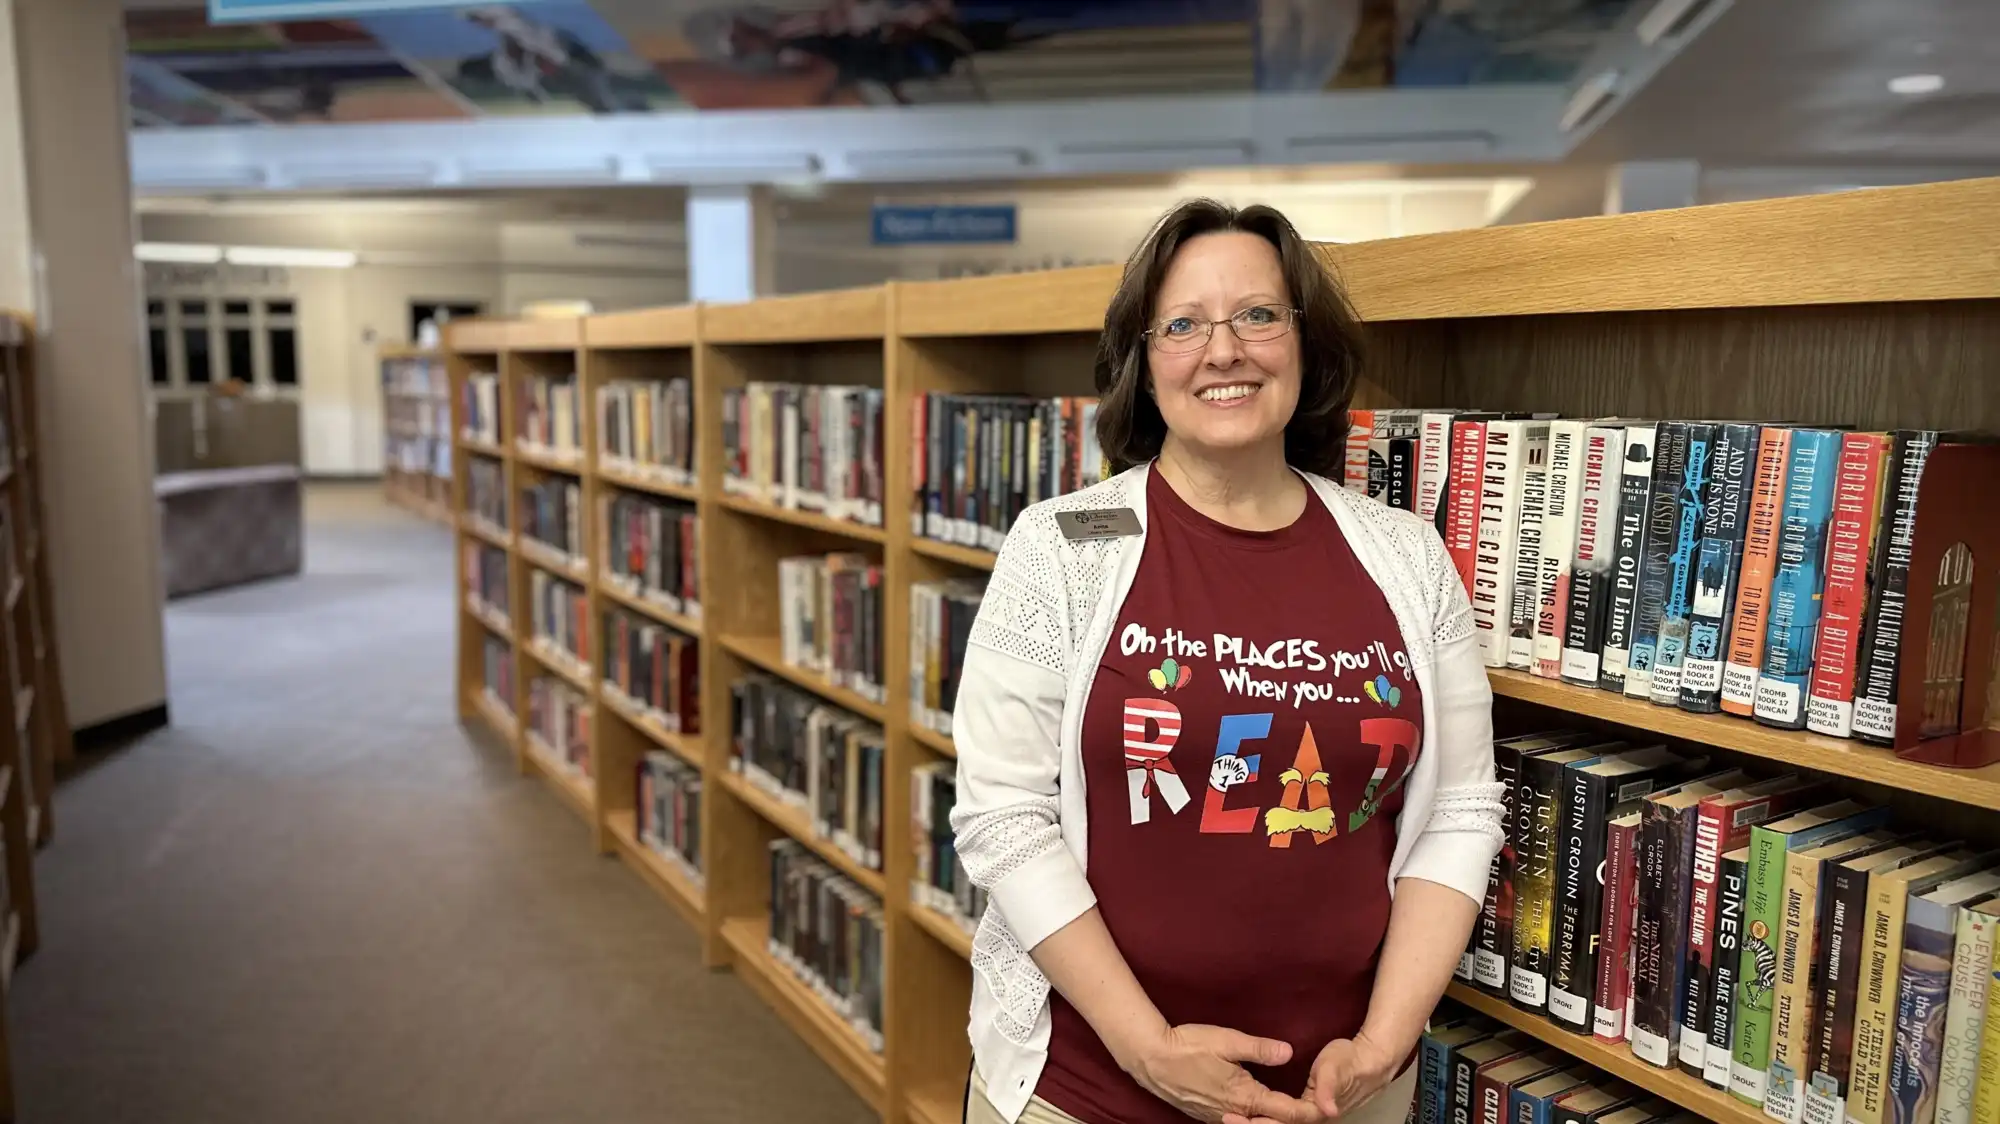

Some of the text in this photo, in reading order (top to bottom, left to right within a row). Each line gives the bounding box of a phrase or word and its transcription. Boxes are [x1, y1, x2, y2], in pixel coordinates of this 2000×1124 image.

[1424, 422, 1442, 473] MICHAEL
[1656, 432, 1672, 473] CROMBIE
[1670, 434, 1685, 475] DEBORAH
[1392, 454, 1402, 505] DISCLO
[1455, 429, 1480, 550] MICHAEL CRICHTON
[1548, 432, 1572, 517] MICHAEL CRICHTON
[1704, 438, 1730, 535] THERE IS NONE
[1720, 447, 1745, 529] AND JUSTICE
[1578, 436, 1605, 560] MICHAEL CRICHTON
[1650, 492, 1676, 535] KISSED
[1748, 440, 1784, 558] DEBORAH CROMBIE
[1780, 448, 1817, 576] DEBORAH CROMBIE
[1886, 440, 1929, 571] DEBORAH CROMBIE
[1474, 432, 1508, 630] MICHAEL CRICHTO
[1480, 528, 1502, 537] NEXT
[1516, 471, 1546, 588] MICHAEL CRICHTON
[1622, 513, 1640, 548] The
[1828, 441, 1870, 592] DEBORAH CROMBIE
[1649, 538, 1670, 546] A
[1616, 556, 1635, 590] Old
[1646, 550, 1668, 576] SAD
[1540, 557, 1560, 606] RISING
[1573, 569, 1592, 622] STATE OF
[1512, 588, 1526, 625] LATITUDES
[1524, 594, 1536, 621] PIRATE
[1607, 596, 1631, 649] Limey
[1638, 580, 1665, 634] GOODBYE
[1738, 586, 1762, 633] TO DWELL
[1772, 591, 1796, 644] GARDEN OF
[1818, 612, 1850, 676] A BITTER
[1872, 589, 1906, 665] A KILLING OF
[1120, 622, 1412, 682] Oh the PLACES you'll g
[1687, 662, 1715, 672] CROMB
[1218, 668, 1288, 699] When
[1654, 676, 1671, 684] BOOK
[1684, 678, 1716, 688] DUNCAN
[1686, 670, 1714, 680] BOOK 8
[1722, 685, 1751, 698] DUNCAN
[1726, 670, 1751, 682] CROMB
[1742, 682, 1753, 691] 16
[1760, 687, 1787, 698] CROMB
[1681, 695, 1708, 705] BANTAM
[1756, 704, 1788, 716] DUNCAN
[1758, 695, 1777, 706] BOOK
[1808, 709, 1840, 720] BOOK 18
[1810, 700, 1838, 712] CROMB
[1856, 710, 1894, 724] BOOK 19
[1860, 702, 1892, 714] CROMB
[1808, 716, 1839, 729] DUNCAN
[1855, 719, 1892, 732] DUNCAN
[1123, 697, 1423, 848] READ
[1214, 758, 1246, 782] THING
[1219, 775, 1229, 788] 1
[1517, 786, 1533, 876] CRONIN
[1533, 790, 1551, 879] JUSTIN
[1566, 776, 1587, 899] JUSTIN CRONIN
[1489, 856, 1500, 887] THE
[1646, 844, 1654, 878] CROOK
[1655, 838, 1664, 889] ELIZABETH
[1752, 839, 1772, 914] Embassy Wife
[1691, 814, 1720, 946] LUTHER THE CALLING
[1563, 903, 1578, 916] THE
[1608, 886, 1616, 913] LOOKING
[1720, 874, 1740, 950] PINES
[1788, 888, 1802, 917] JAMES
[1513, 895, 1524, 962] MIRRORS
[1529, 899, 1542, 970] THE CITY
[1786, 917, 1800, 928] D.
[1875, 910, 1890, 940] JAMES
[1638, 915, 1650, 982] JOURNAL
[1782, 928, 1799, 984] CROWNOVER
[1828, 900, 1846, 981] JAMES CROWNOVER
[1874, 939, 1888, 949] D.
[1475, 968, 1498, 980] PASSAGE
[1476, 961, 1490, 971] BOOK
[1478, 954, 1495, 965] CRONI
[1868, 950, 1887, 1004] CROWNOVER
[1953, 944, 1972, 999] CRUSIE
[1512, 986, 1536, 999] PASSAGE
[1513, 980, 1530, 990] BOOK
[1514, 973, 1534, 984] CRONI
[1688, 978, 1699, 998] NEIL
[1716, 967, 1731, 1003] BLAKE
[1553, 997, 1572, 1010] CRONI
[1686, 1000, 1698, 1029] CROSS
[1826, 988, 1836, 1008] THE
[1778, 994, 1792, 1039] TRIPLE
[1956, 934, 1990, 1111] JENNIFER LOOK
[1745, 1020, 1757, 1050] Katie
[1890, 975, 1914, 1096] michael crummey
[1907, 995, 1930, 1087] the innocents
[1424, 1047, 1439, 1090] CLIVE
[1854, 1020, 1871, 1095] COULD TALK
[1865, 1010, 1886, 1112] IF THESE WALLS
[1943, 1035, 1961, 1088] DOWN
[1456, 1062, 1470, 1108] CLIVE
[1732, 1074, 1757, 1088] CROUC
[1766, 1088, 1795, 1104] CROWN
[1766, 1096, 1787, 1108] BOOK
[1766, 1105, 1793, 1120] TRIPLE
[1806, 1094, 1835, 1112] CROWN
[1806, 1103, 1827, 1115] BOOK
